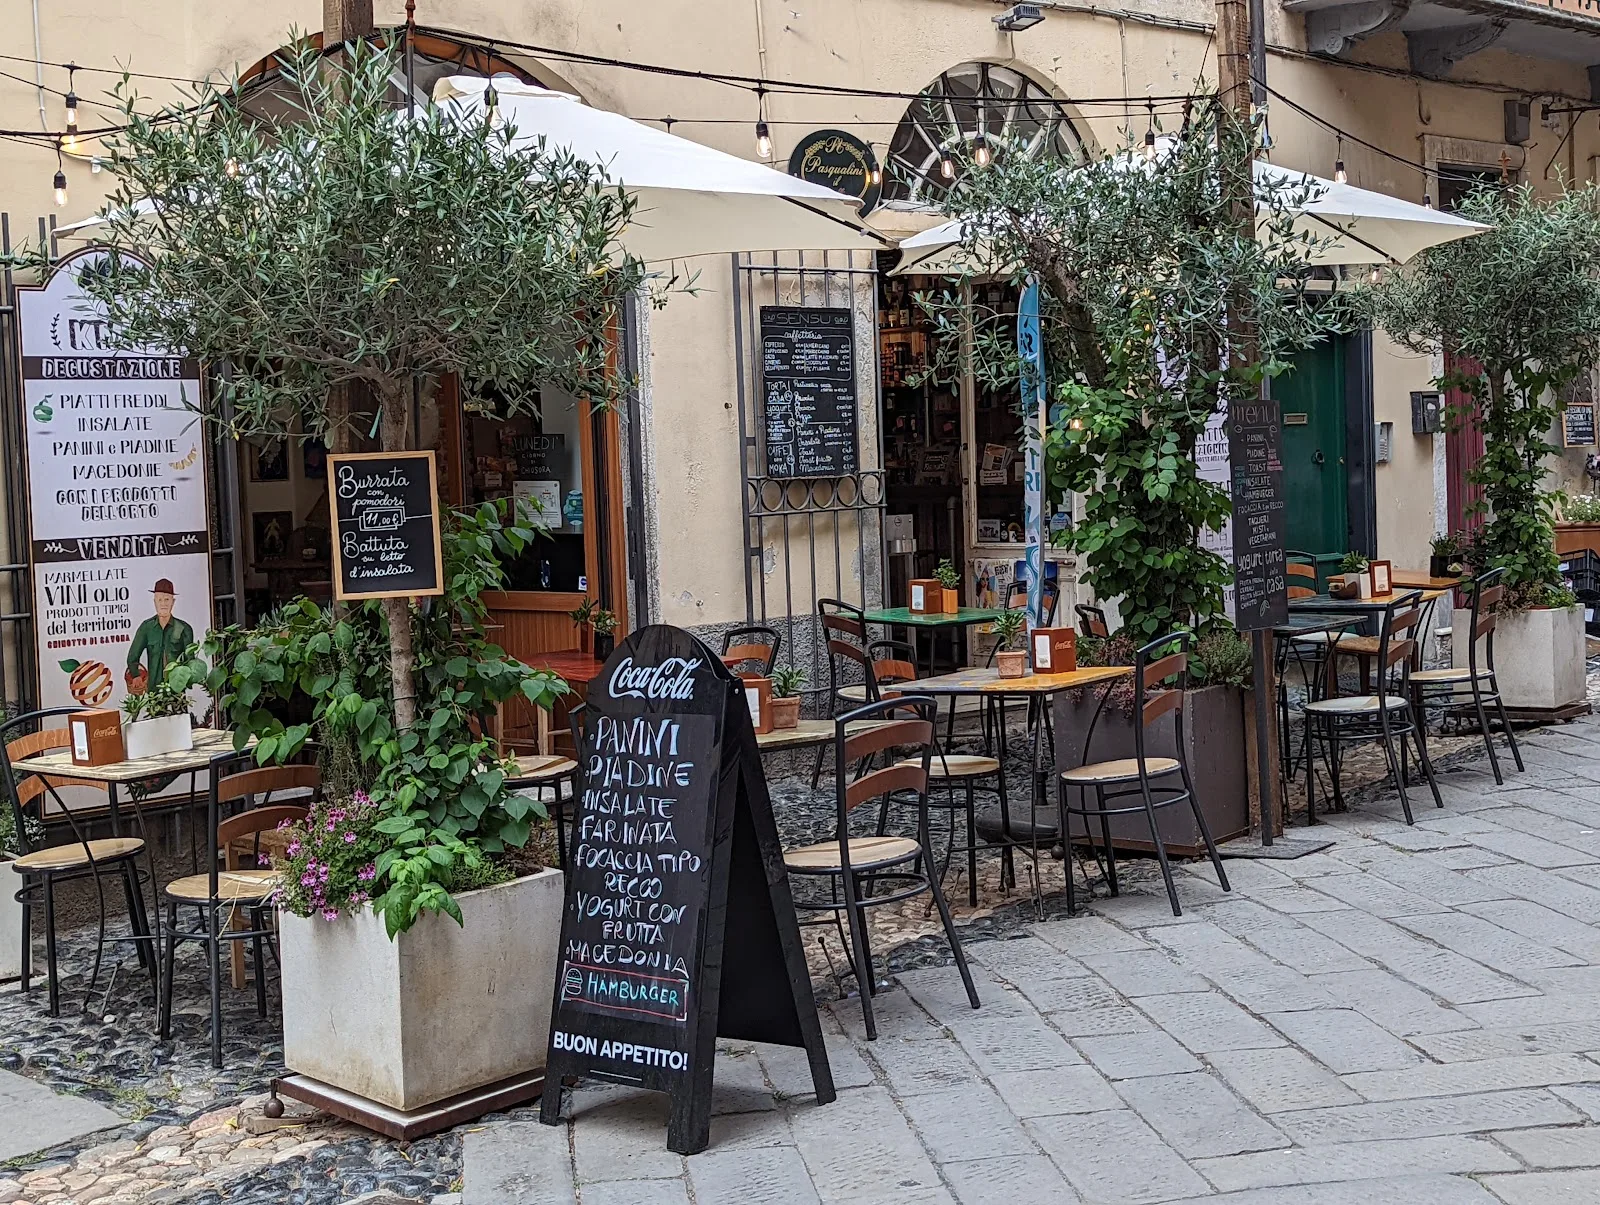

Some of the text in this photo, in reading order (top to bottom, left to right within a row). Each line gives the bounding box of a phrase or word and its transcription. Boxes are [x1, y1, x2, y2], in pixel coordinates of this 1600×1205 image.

[805, 155, 864, 178] Pasqualini
[776, 312, 831, 325] SENSU
[42, 358, 182, 379] DEGUSTAZIONE
[766, 381, 788, 391] TORTA
[60, 392, 169, 410] PIATTI FREDDI
[766, 405, 792, 416] yogurt
[77, 416, 153, 432] INSALATE
[1231, 405, 1277, 425] menu
[53, 439, 178, 457] PANINI e PIADINE
[1246, 434, 1265, 443] PANINI
[73, 462, 163, 480] MACEDONIE
[769, 462, 789, 475] MOKA
[1248, 463, 1267, 472] TOAST
[338, 465, 410, 499] Burrata
[1245, 476, 1271, 487] INSALATE
[56, 486, 178, 505] CON I PRODOTTI
[366, 488, 384, 496] con
[1245, 488, 1275, 501] HAMBURGER
[81, 503, 159, 522] DELL'ORTO
[352, 494, 405, 516] pomodori
[1237, 503, 1262, 515] FOCACCIA
[1270, 501, 1284, 510] RECCO
[1247, 515, 1270, 526] TAGLIERI
[1252, 525, 1267, 535] MISTI
[76, 534, 170, 560] VENDITA
[342, 531, 409, 559] Battuta
[379, 552, 406, 562] letto
[1237, 552, 1264, 573] yogurt
[1264, 548, 1283, 565] torta
[44, 568, 129, 585] MARMELLATE
[349, 563, 415, 578] d'insalata
[44, 583, 130, 606] VINI OLIO
[1266, 576, 1285, 595] casa
[46, 603, 129, 619] PRODOTTI TIPICI
[47, 615, 132, 636] del territorio
[47, 634, 131, 650] CHINOTTO DI SAVONA
[608, 656, 704, 700] Coca-Cola
[93, 726, 118, 738] Coca-Cola
[595, 715, 681, 759] PANINI
[587, 754, 694, 790] PIADINE
[584, 789, 678, 819] INSALATE
[581, 814, 678, 846] FARINATA
[576, 843, 702, 874] FOCACCIA TIPO
[576, 891, 688, 925] YOGURT CON
[602, 920, 666, 945] FRUTTA
[568, 939, 690, 979] MACEDONIA
[587, 971, 680, 1007] HAMBURGER
[553, 1030, 689, 1071] BUON APPETITO!
